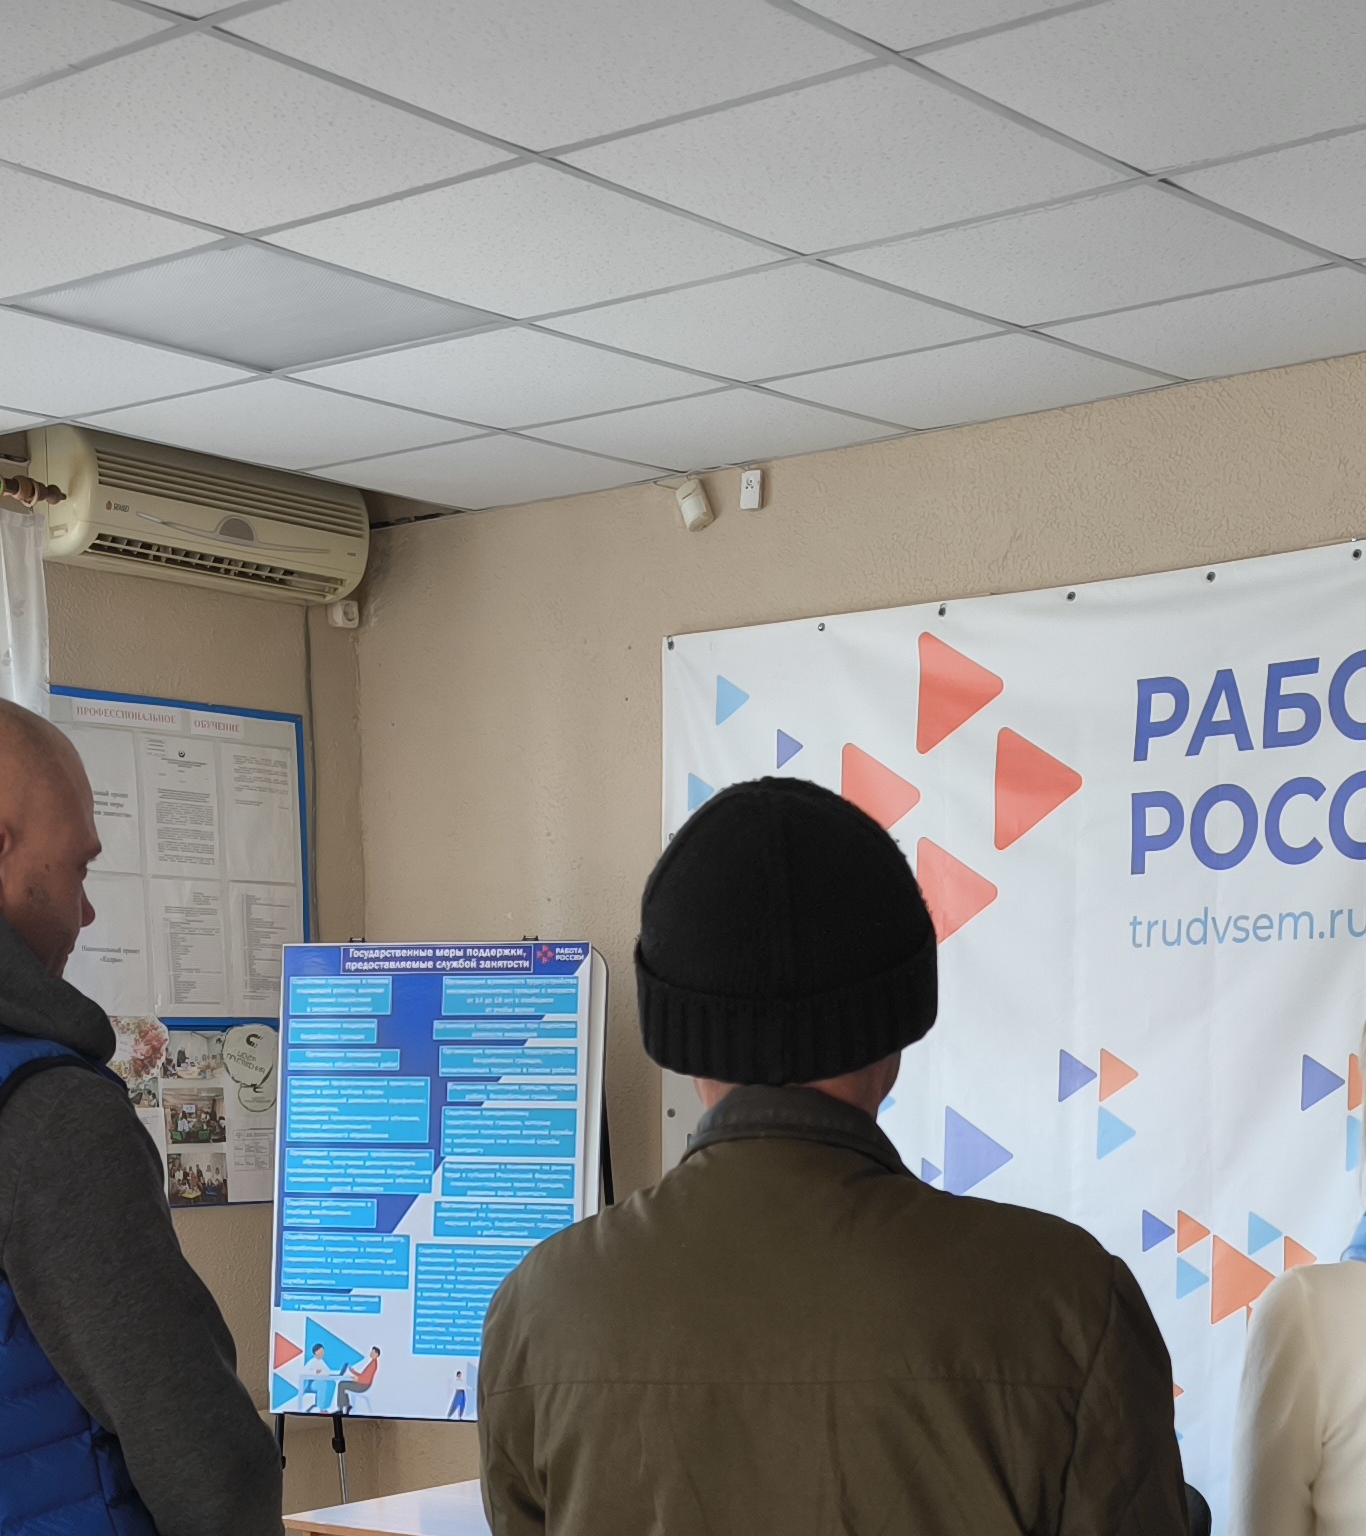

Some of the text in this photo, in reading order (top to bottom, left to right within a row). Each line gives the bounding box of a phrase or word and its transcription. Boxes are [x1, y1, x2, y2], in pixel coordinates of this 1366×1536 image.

[76, 706, 240, 733] ПРОФЕССИОНАЛЬНОЕ ОБУЧЕНИЕ
[349, 948, 527, 960] Государственные меры поддержки,
[345, 960, 530, 971] предоставляемые службой занятости
